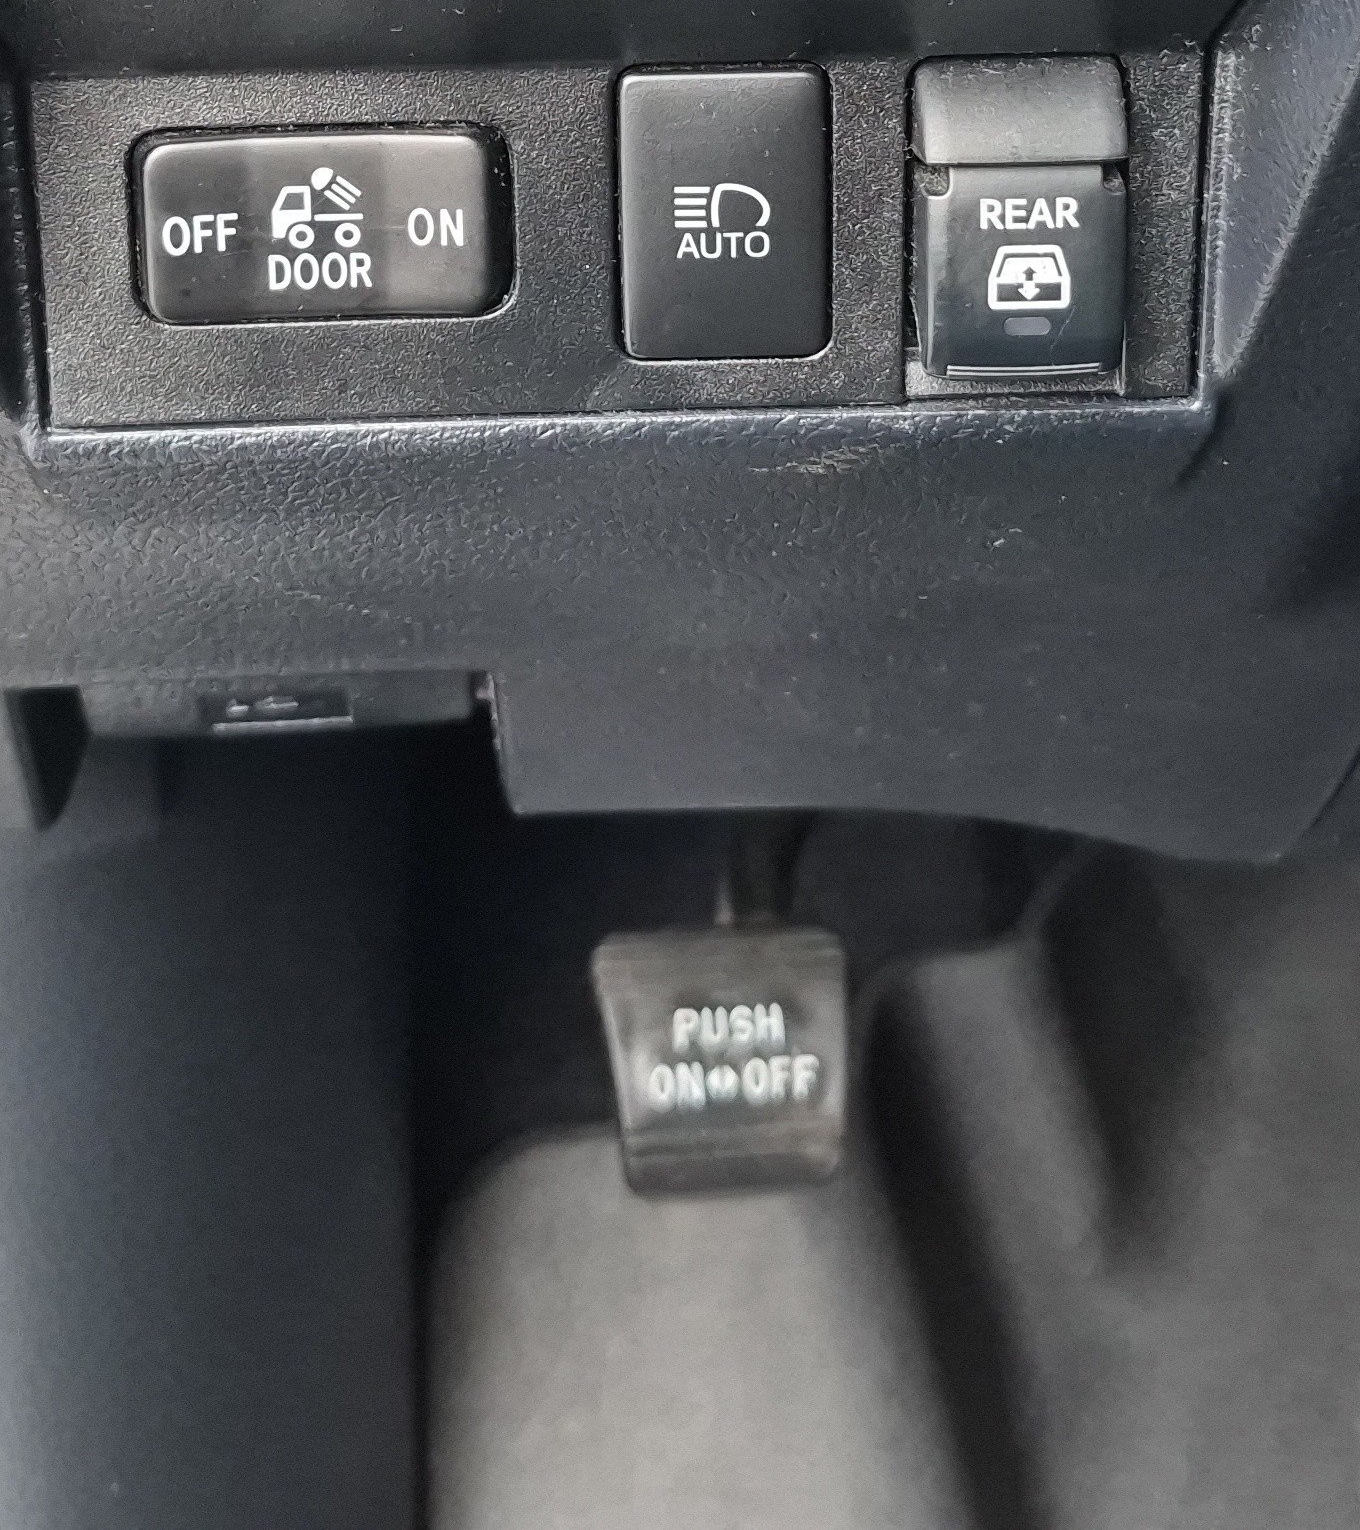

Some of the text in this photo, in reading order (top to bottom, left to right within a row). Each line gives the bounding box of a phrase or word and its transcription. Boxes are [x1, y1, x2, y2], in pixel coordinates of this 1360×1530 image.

[407, 207, 464, 247] ON
[979, 196, 1080, 230] REAR
[161, 212, 239, 257] OFF
[676, 230, 770, 260] AUTO
[267, 251, 373, 291] DOOR
[671, 1002, 786, 1054] PUSH
